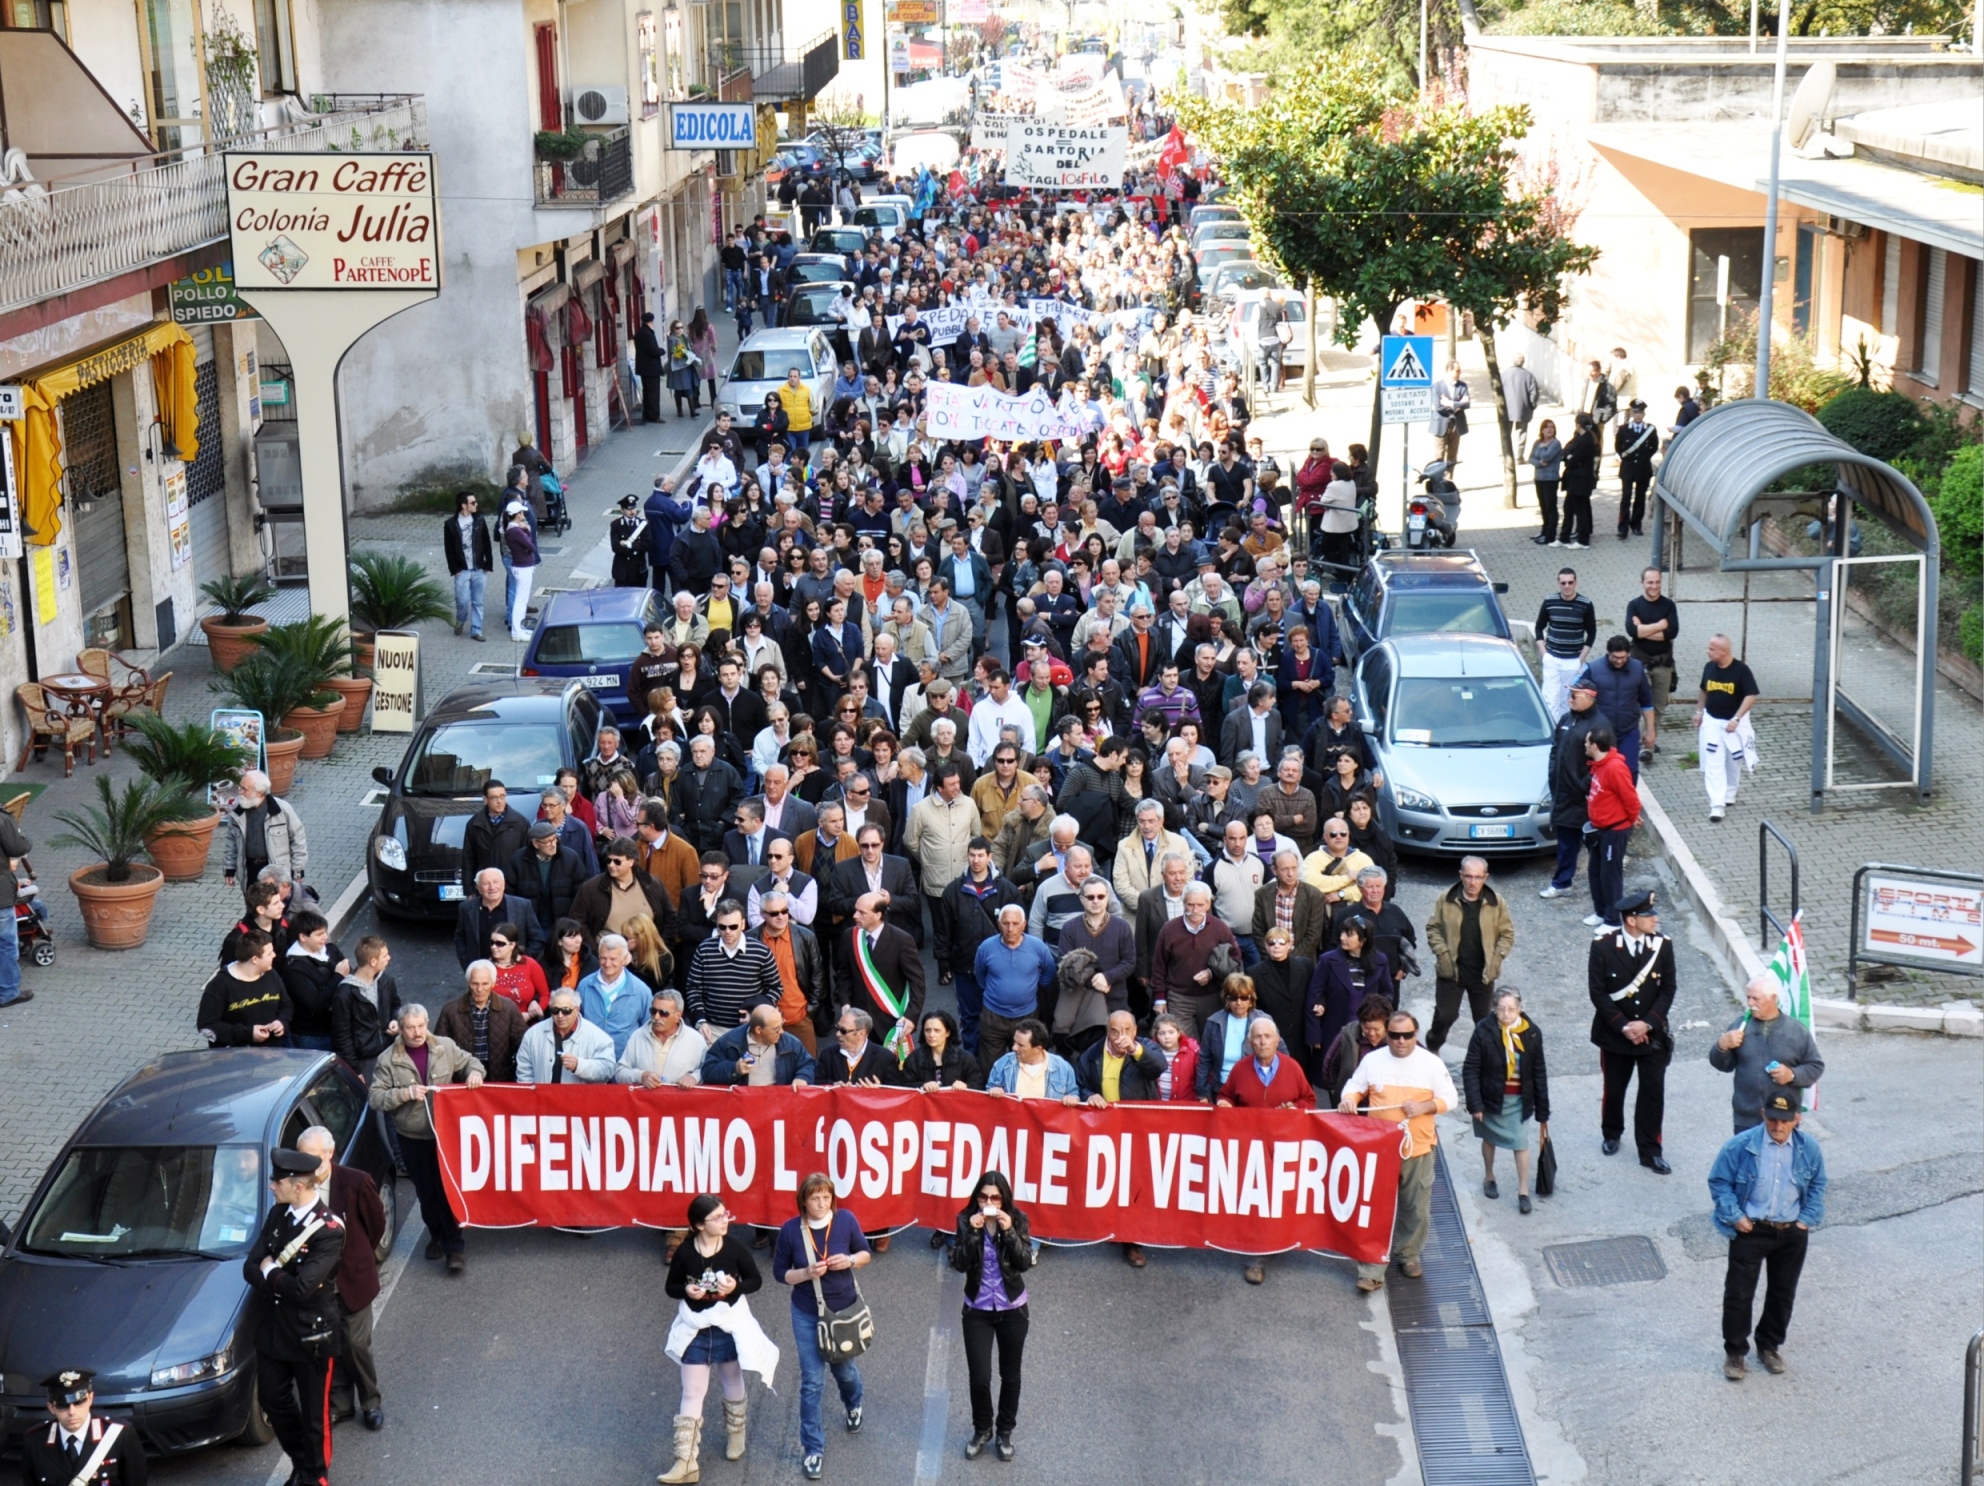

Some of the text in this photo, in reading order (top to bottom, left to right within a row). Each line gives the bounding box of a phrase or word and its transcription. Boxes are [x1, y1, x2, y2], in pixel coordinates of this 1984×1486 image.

[845, 4, 861, 60] BAR
[675, 112, 752, 141] EDICOLA
[1024, 127, 1108, 139] OSPEDALE
[1024, 143, 1105, 162] SARTORIA
[1056, 159, 1081, 169] DEL
[232, 160, 427, 193] Gran Caffè
[236, 202, 430, 243] Colonia Julia
[332, 257, 432, 283] PARTENOPE
[173, 286, 227, 302] POLLO
[175, 304, 236, 322] SPIEDO
[76, 336, 148, 385] PASTICCERIA
[1397, 390, 1427, 399] VIETATO
[1384, 408, 1405, 416] MOTORE
[377, 648, 415, 672] NUOVA
[374, 690, 413, 714] GESTIONE
[1899, 934, 1941, 949] 50 mt.
[459, 1114, 757, 1194] DIFENDIAMO
[1085, 1133, 1132, 1209] DI
[1148, 1132, 1379, 1230] VENAFRO!
